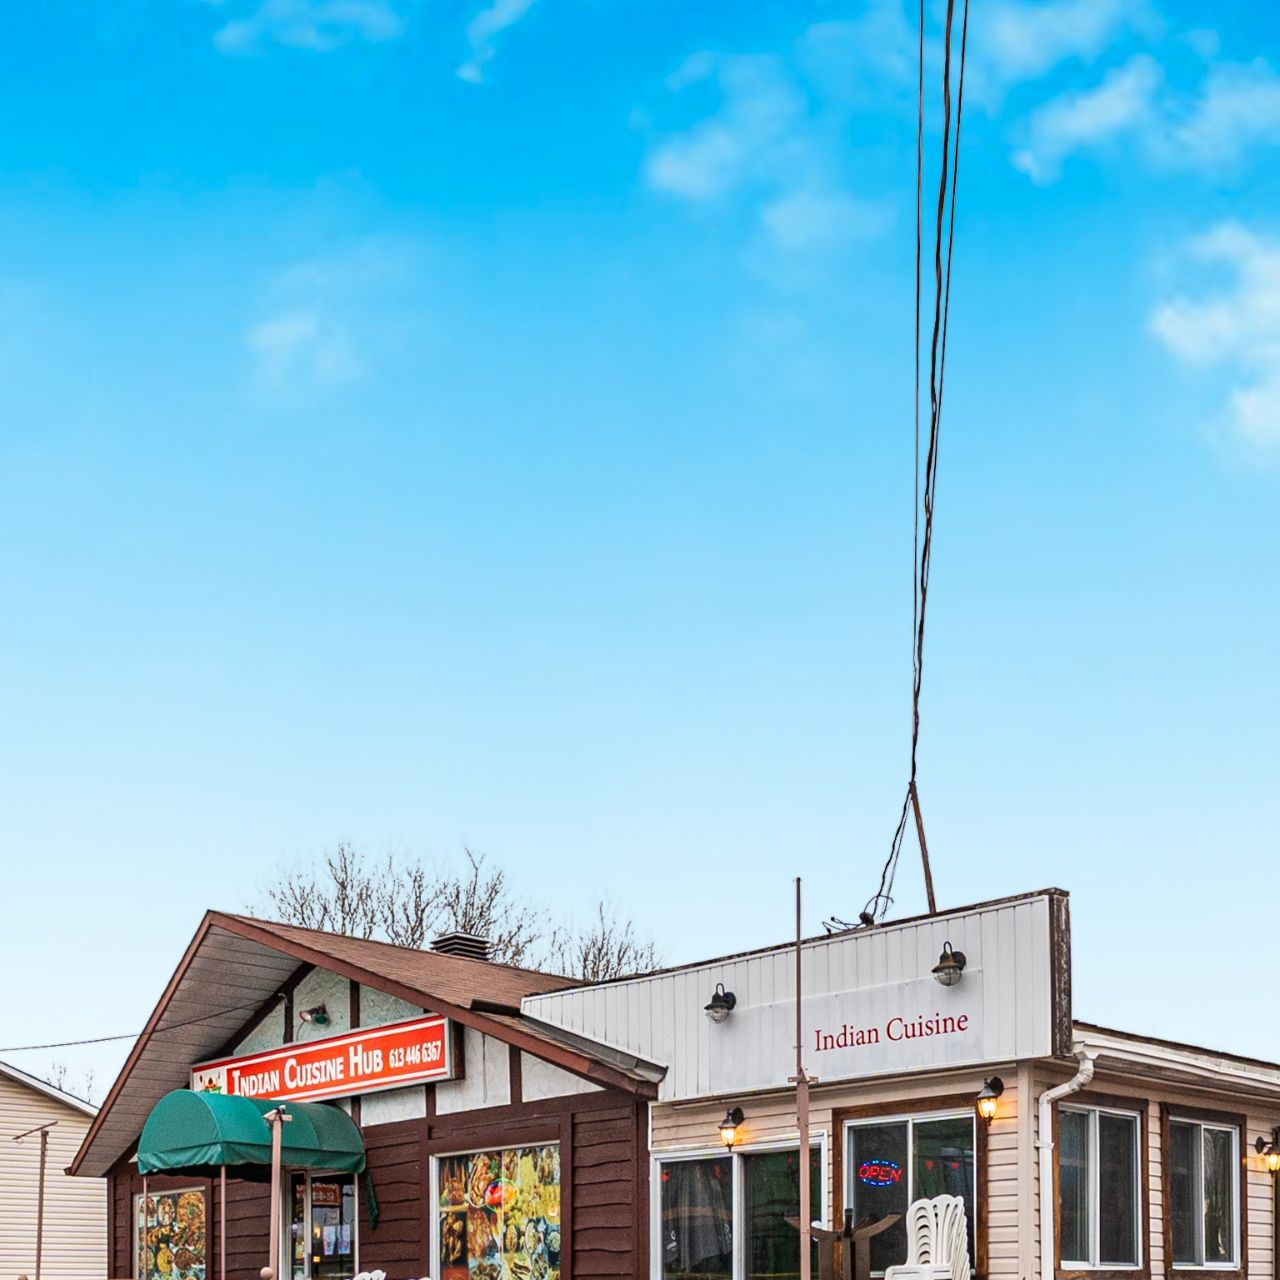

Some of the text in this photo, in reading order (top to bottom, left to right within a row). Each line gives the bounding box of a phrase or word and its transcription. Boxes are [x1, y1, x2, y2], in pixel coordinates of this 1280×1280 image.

[814, 1012, 969, 1052] Indian Cuisine
[232, 1040, 442, 1097] INDIAN CUISINE HUB 613 446 6367
[859, 1165, 903, 1182] OPEN
